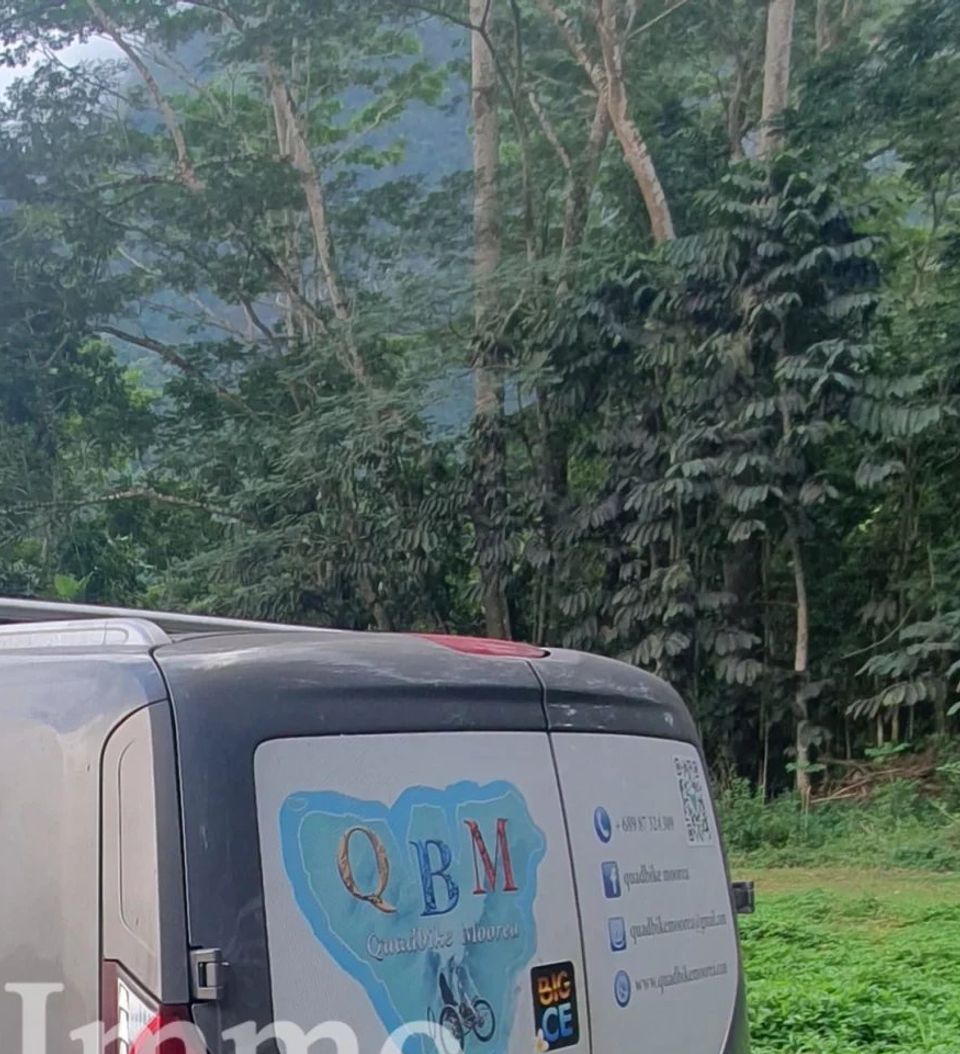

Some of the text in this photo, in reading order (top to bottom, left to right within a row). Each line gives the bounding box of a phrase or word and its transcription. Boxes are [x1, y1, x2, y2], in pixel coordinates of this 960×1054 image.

[337, 818, 518, 916] QBM
[366, 922, 520, 960] Quadbike Moorea
[538, 971, 571, 1005] BIG
[542, 1002, 573, 1042] CE
